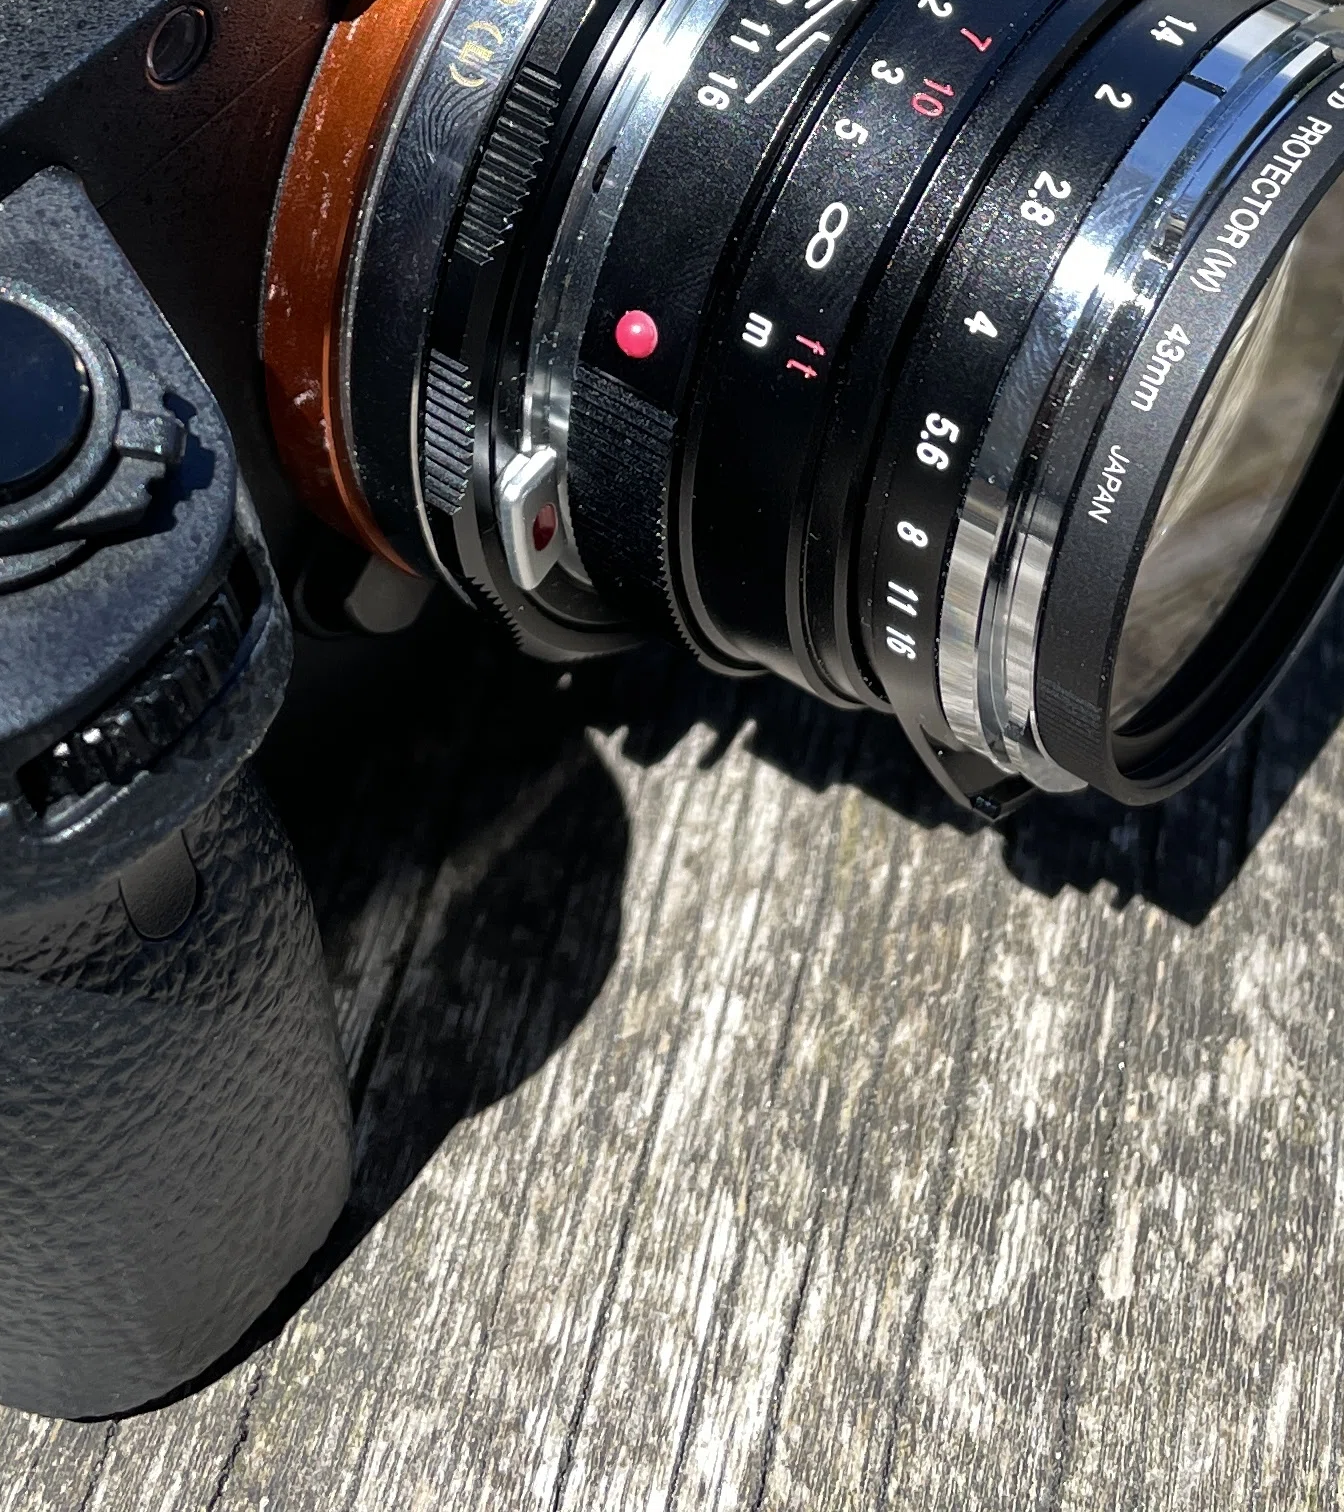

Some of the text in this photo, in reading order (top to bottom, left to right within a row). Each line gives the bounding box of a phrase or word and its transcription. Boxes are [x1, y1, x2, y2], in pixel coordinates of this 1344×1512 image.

[730, 18, 771, 53] 11
[960, 27, 993, 52] 7
[697, 71, 739, 111] 16
[871, 60, 905, 85] 3
[910, 78, 955, 117] 10
[834, 118, 869, 146] 5
[1216, 115, 1333, 249] PROTECTOR
[1189, 248, 1238, 293] (W)
[741, 312, 773, 348] m
[885, 15, 1197, 660] 1.4 2 2.8 4 5.6 8 11 16
[785, 334, 826, 379] ft
[1131, 322, 1192, 412] 43mm
[1087, 444, 1131, 524] JAPAN
